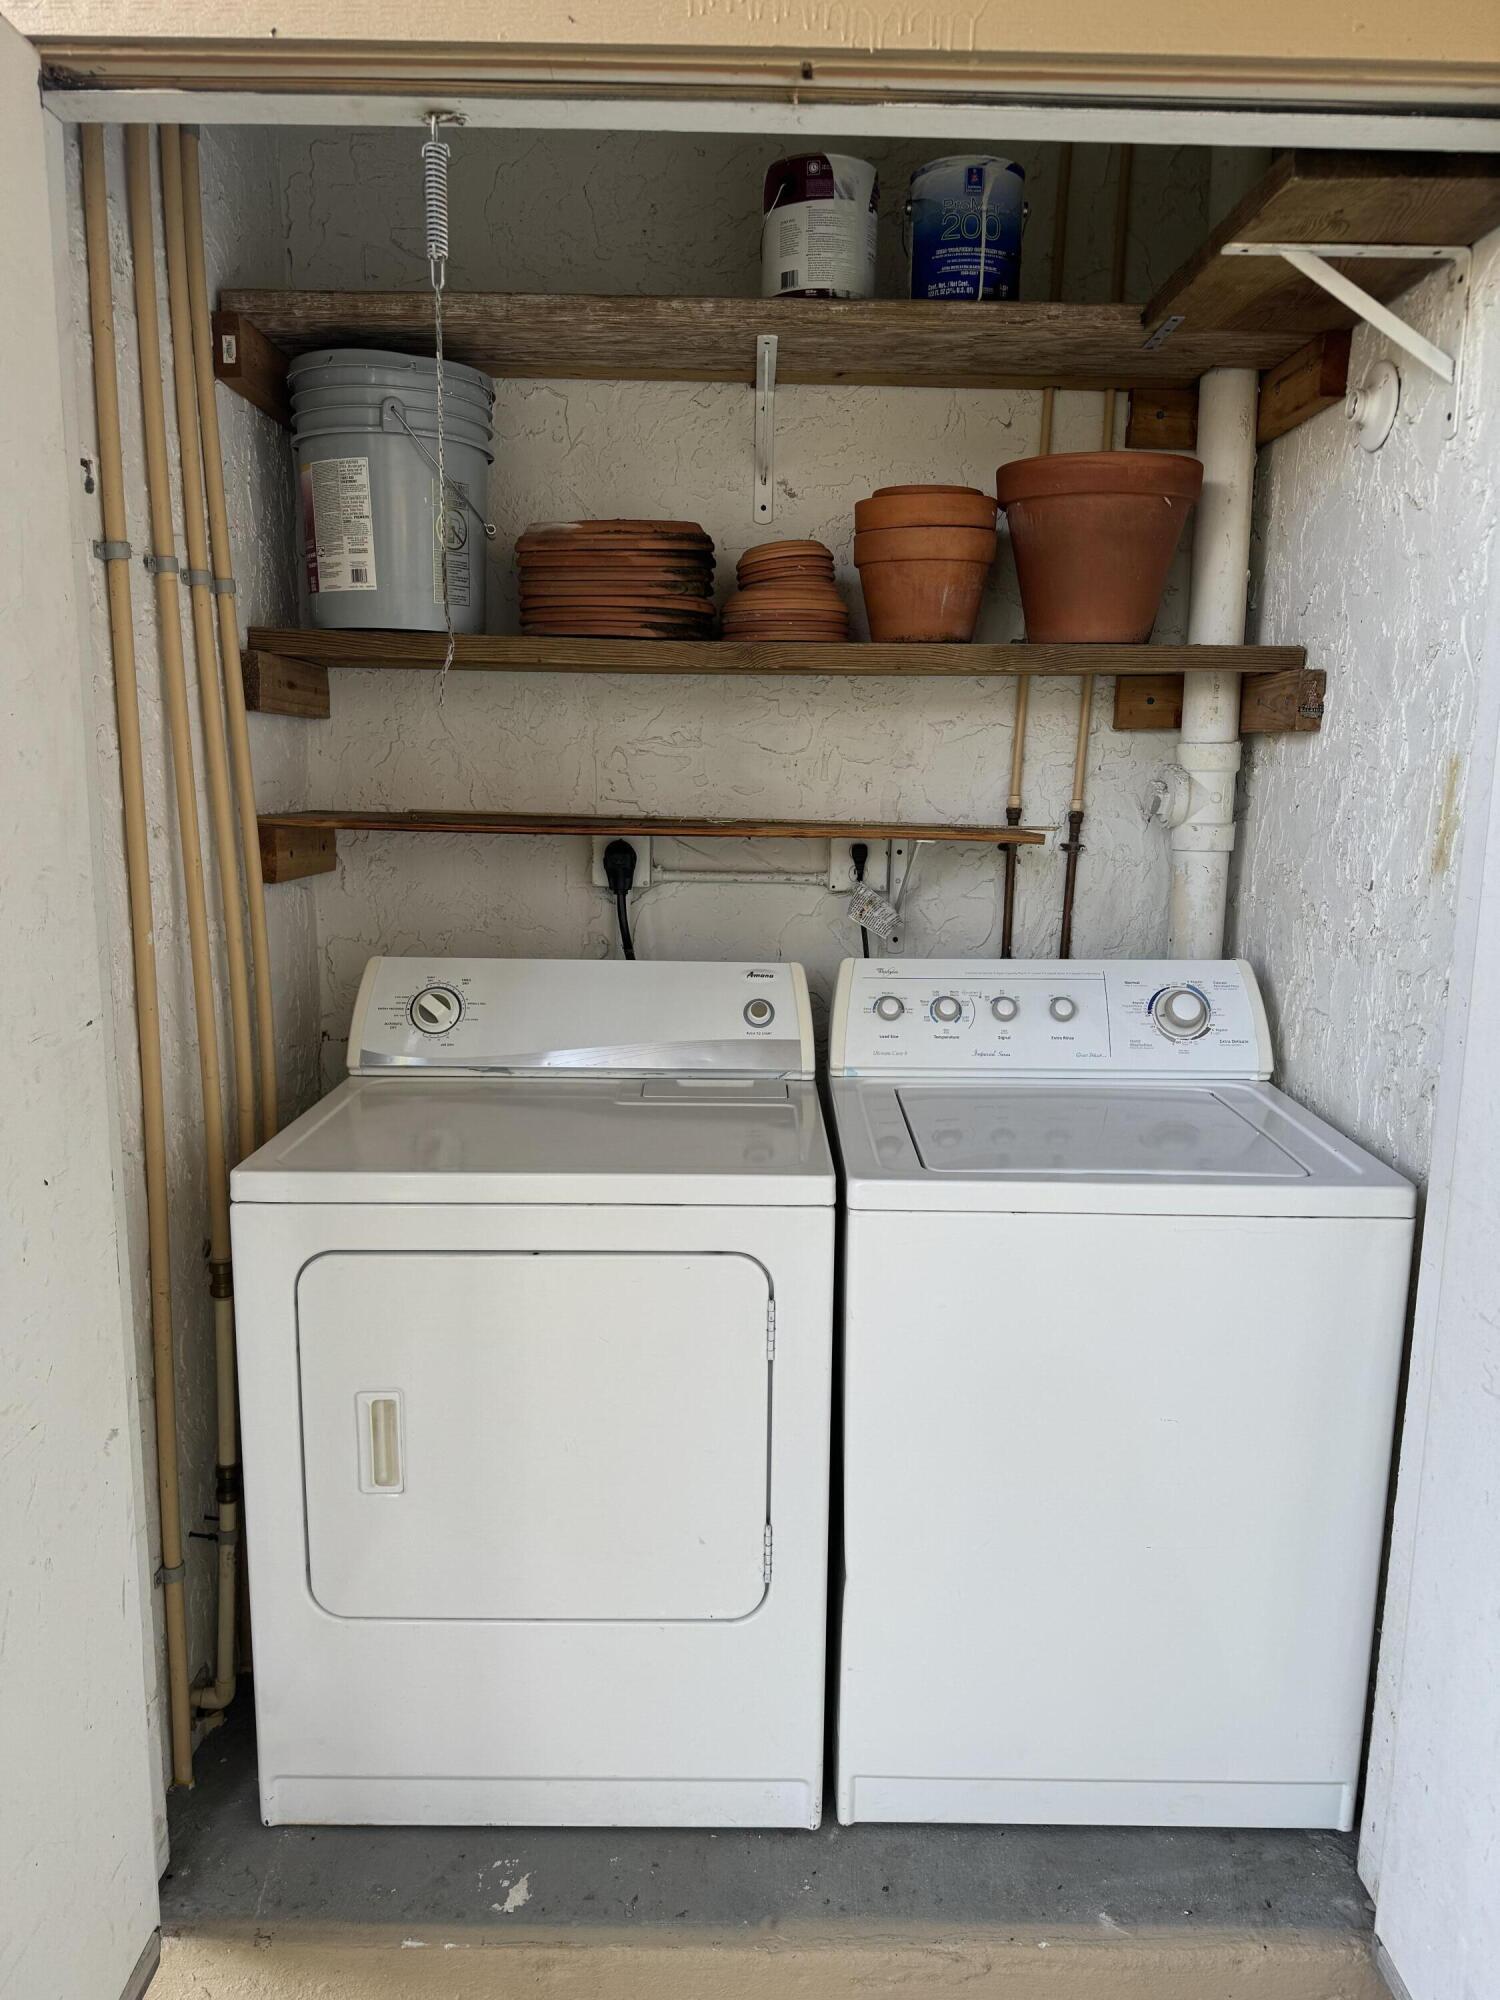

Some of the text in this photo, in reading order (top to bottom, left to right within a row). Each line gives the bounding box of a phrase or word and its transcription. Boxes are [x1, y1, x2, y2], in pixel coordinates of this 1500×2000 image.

[943, 197, 1000, 214] ProMr
[941, 212, 1001, 241] 200
[746, 971, 774, 979] Amana
